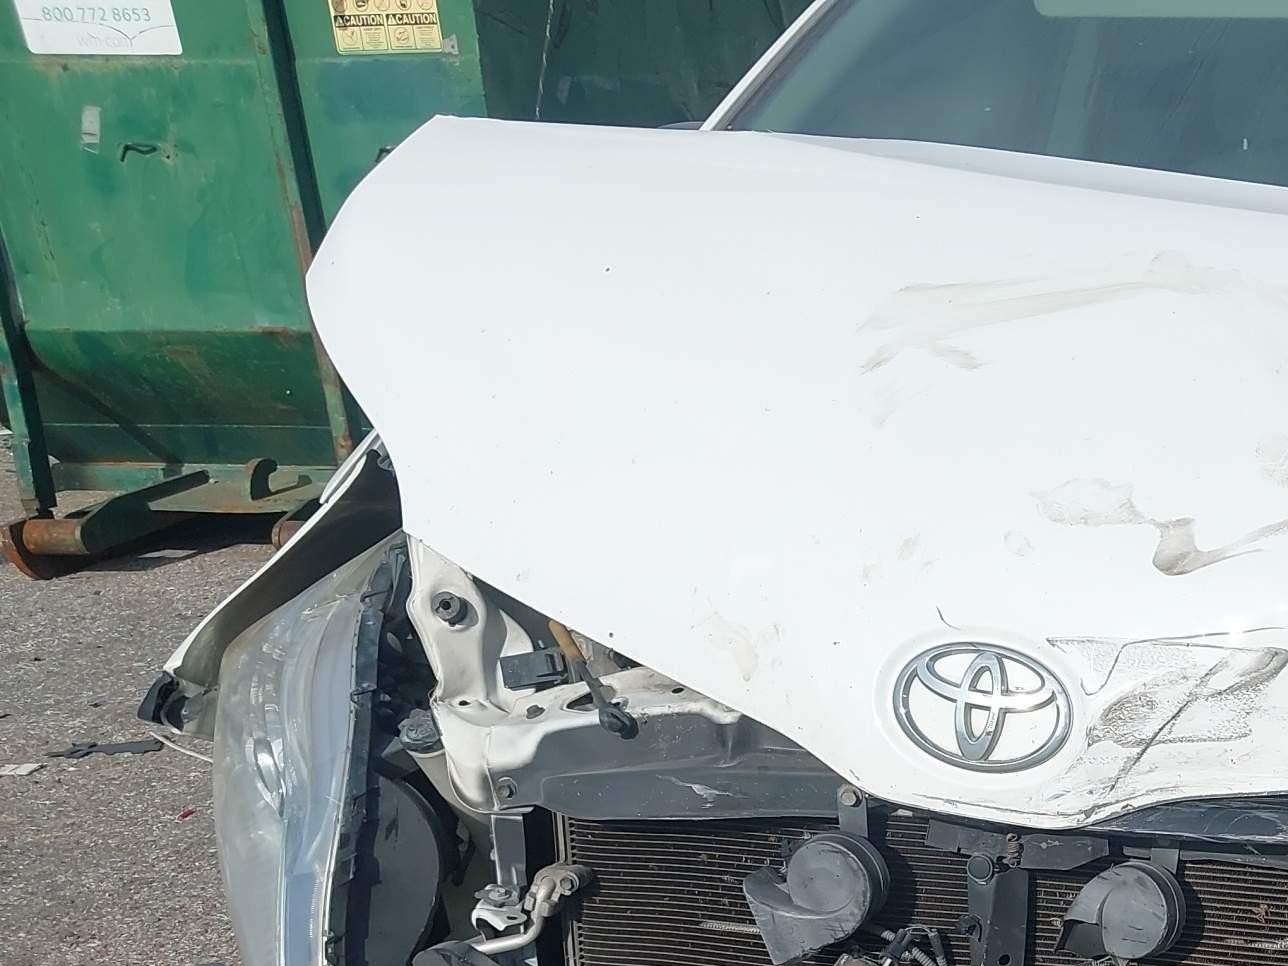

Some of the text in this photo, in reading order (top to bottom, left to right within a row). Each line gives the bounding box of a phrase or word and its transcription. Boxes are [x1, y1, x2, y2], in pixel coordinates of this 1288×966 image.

[41, 7, 151, 22] 800 772 8653
[343, 14, 384, 26] CAUTION
[395, 13, 437, 24] CAUTION
